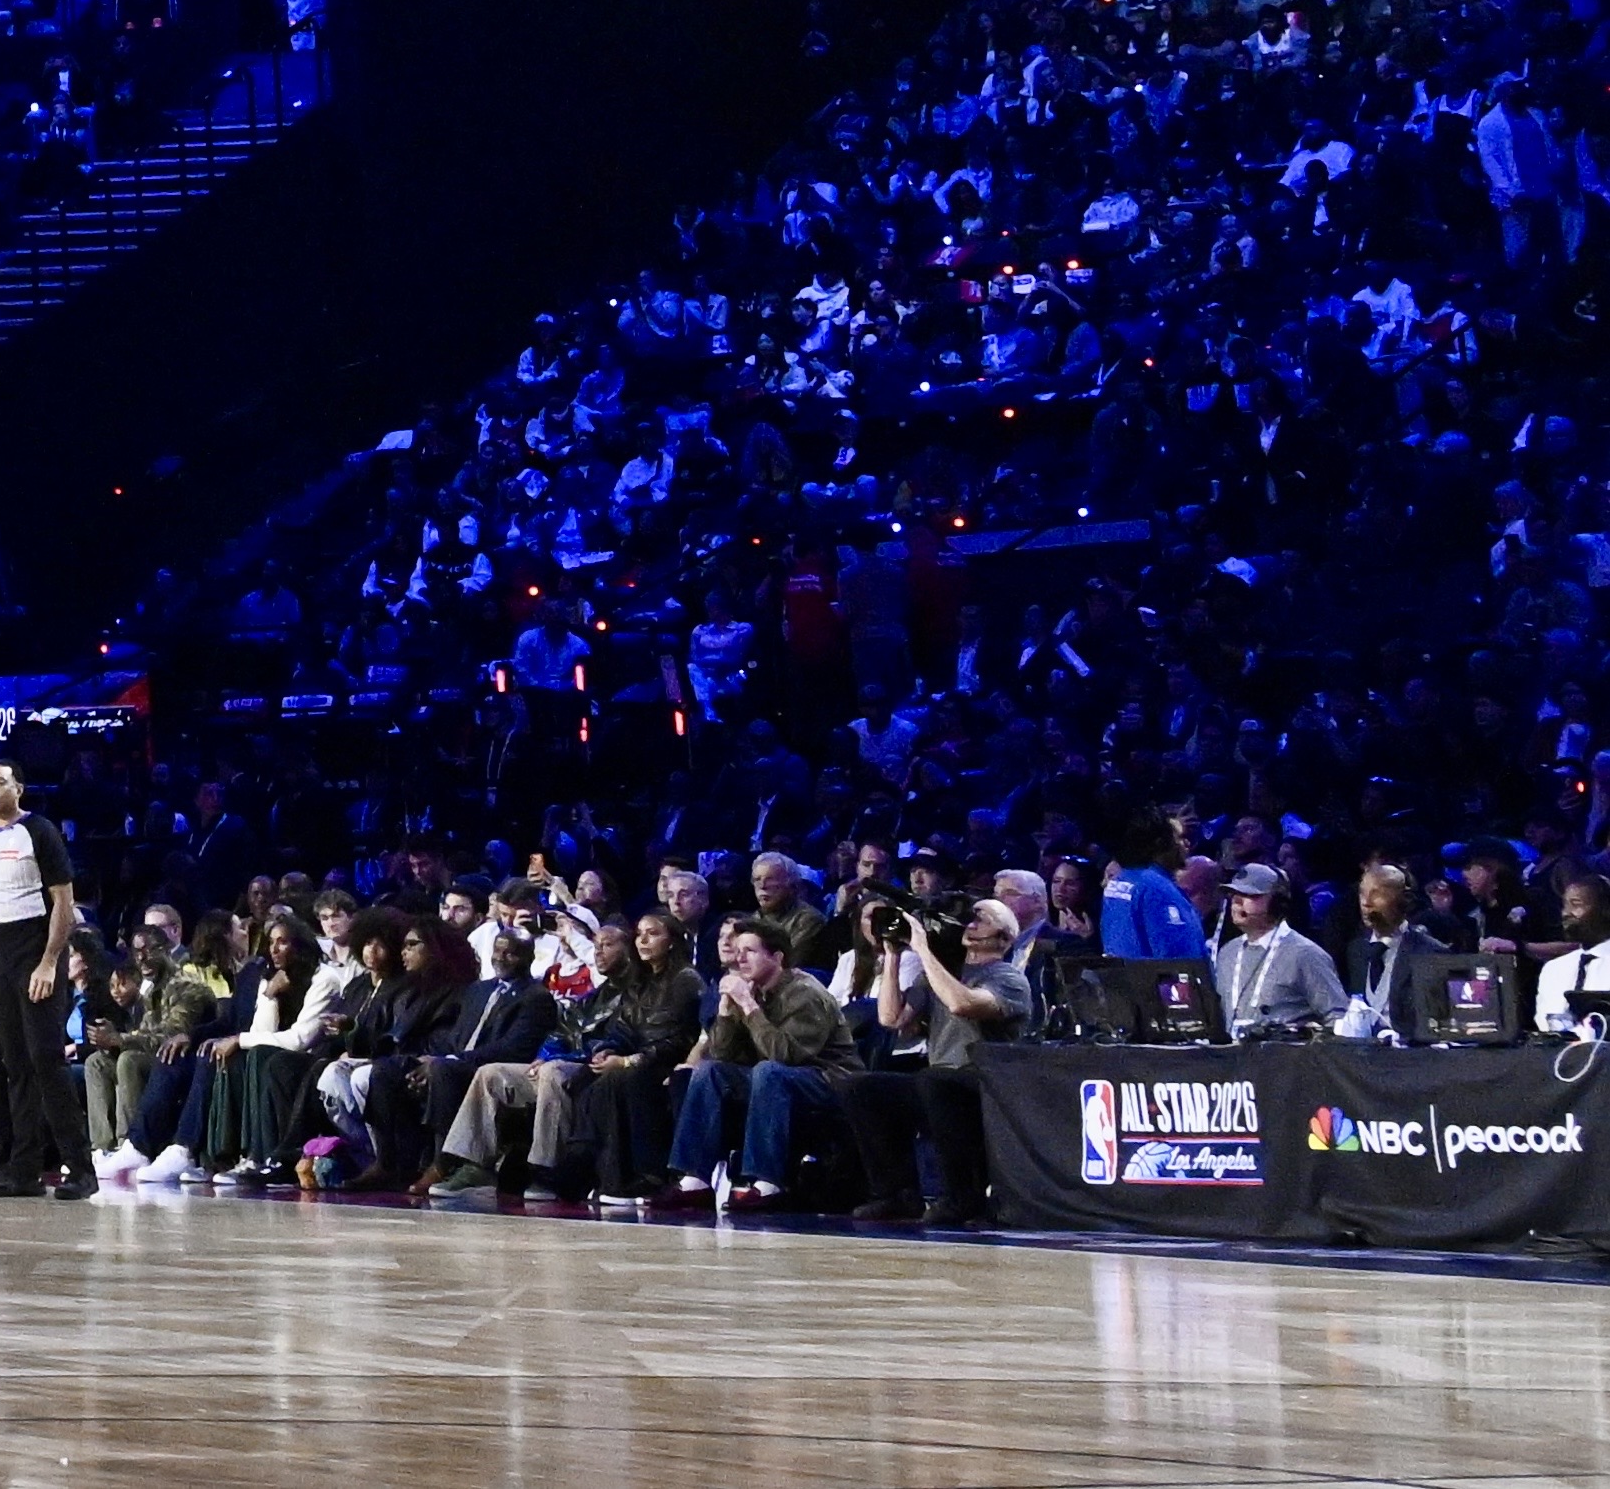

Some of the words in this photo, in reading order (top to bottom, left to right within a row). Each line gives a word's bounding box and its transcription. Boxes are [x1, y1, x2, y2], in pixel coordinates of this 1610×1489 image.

[1121, 1085, 1156, 1134] ALL
[1157, 1083, 1209, 1134] STAR
[1209, 1081, 1257, 1133] 2026
[1165, 1148, 1194, 1172] Los
[1195, 1146, 1256, 1173] Angeles
[1359, 1120, 1424, 1156] NBC
[1445, 1113, 1582, 1169] peacock
